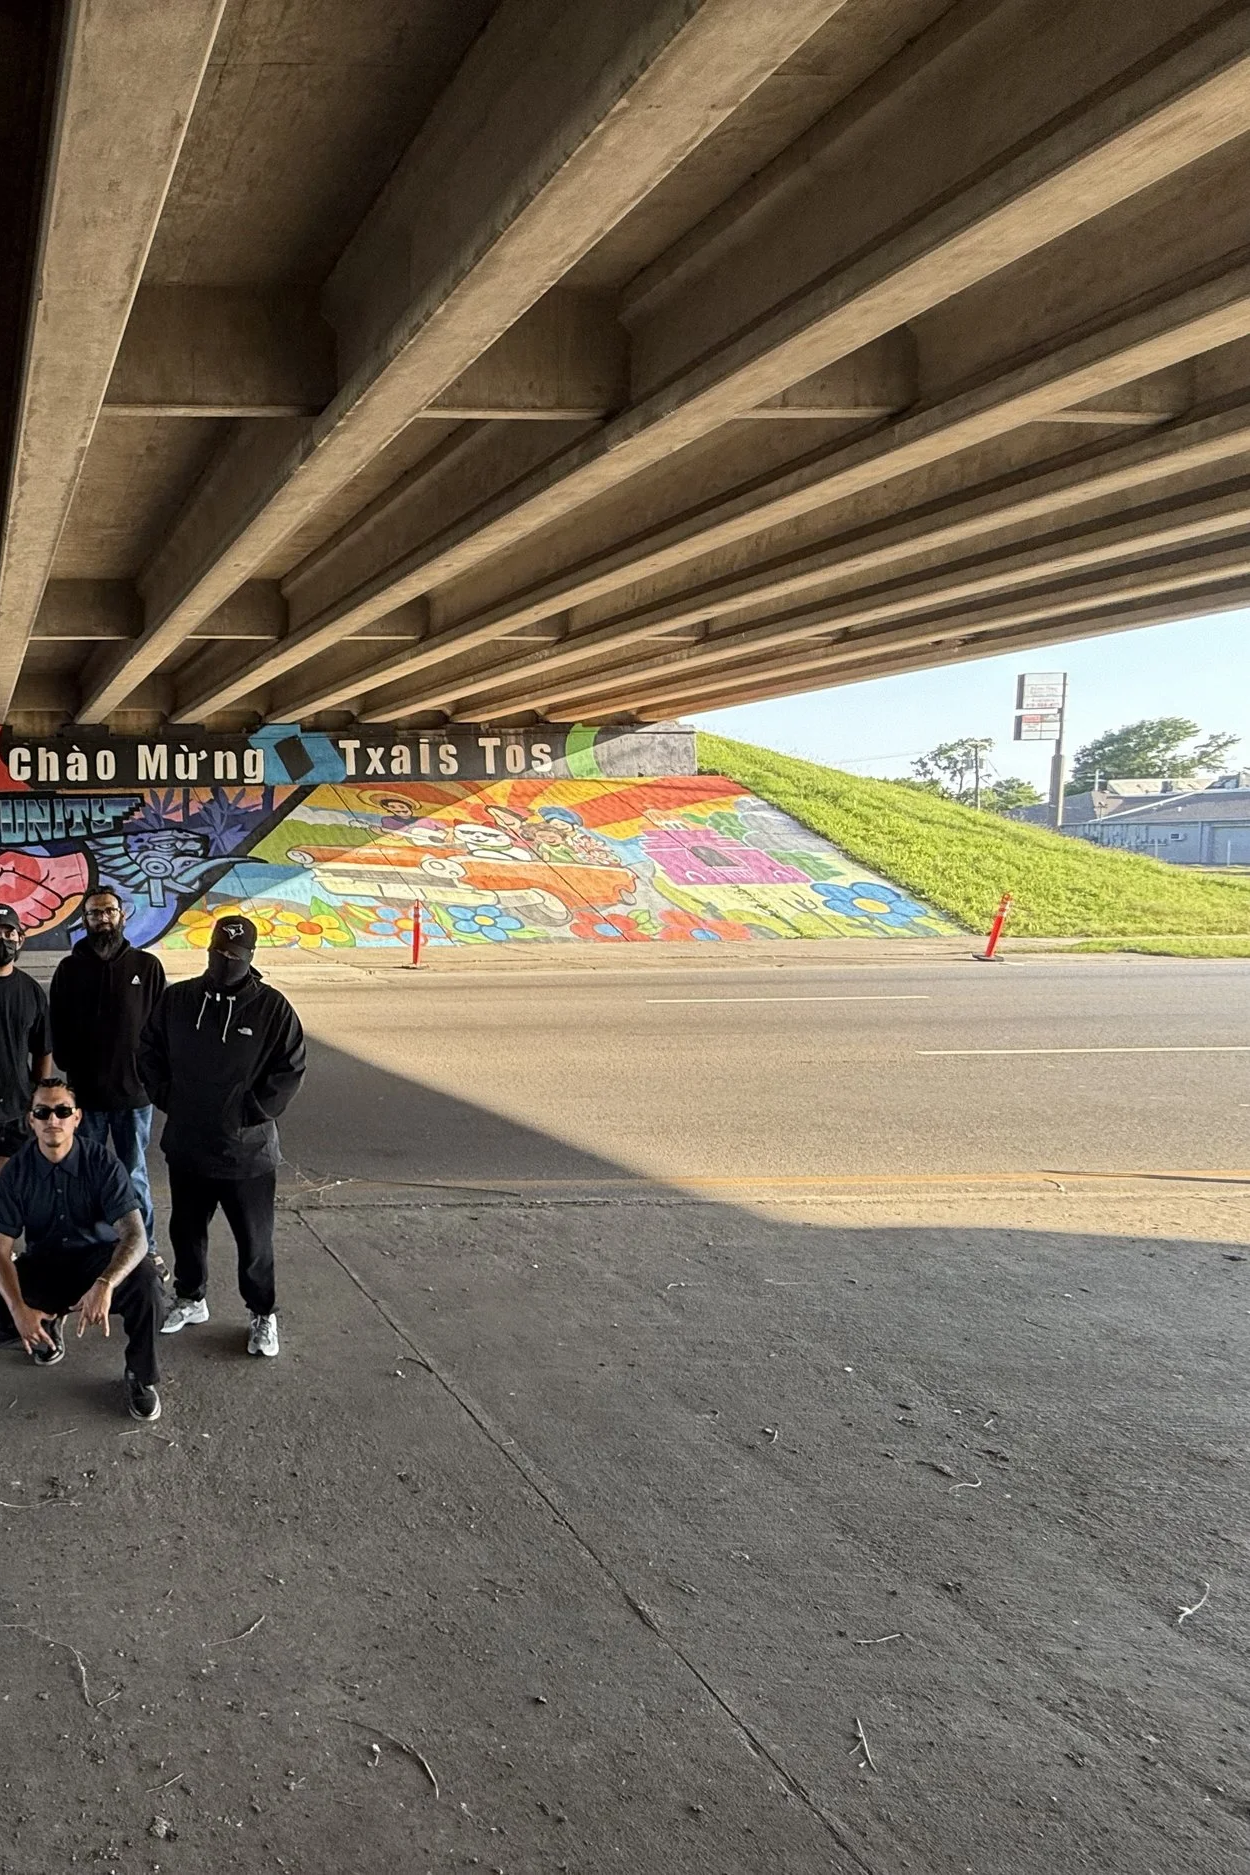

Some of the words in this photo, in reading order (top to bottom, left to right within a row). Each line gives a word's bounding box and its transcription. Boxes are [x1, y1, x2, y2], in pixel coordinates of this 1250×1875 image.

[8, 744, 116, 782] Chào
[137, 744, 265, 784] Mừng
[338, 738, 459, 776] Txais
[478, 737, 553, 774] Tos
